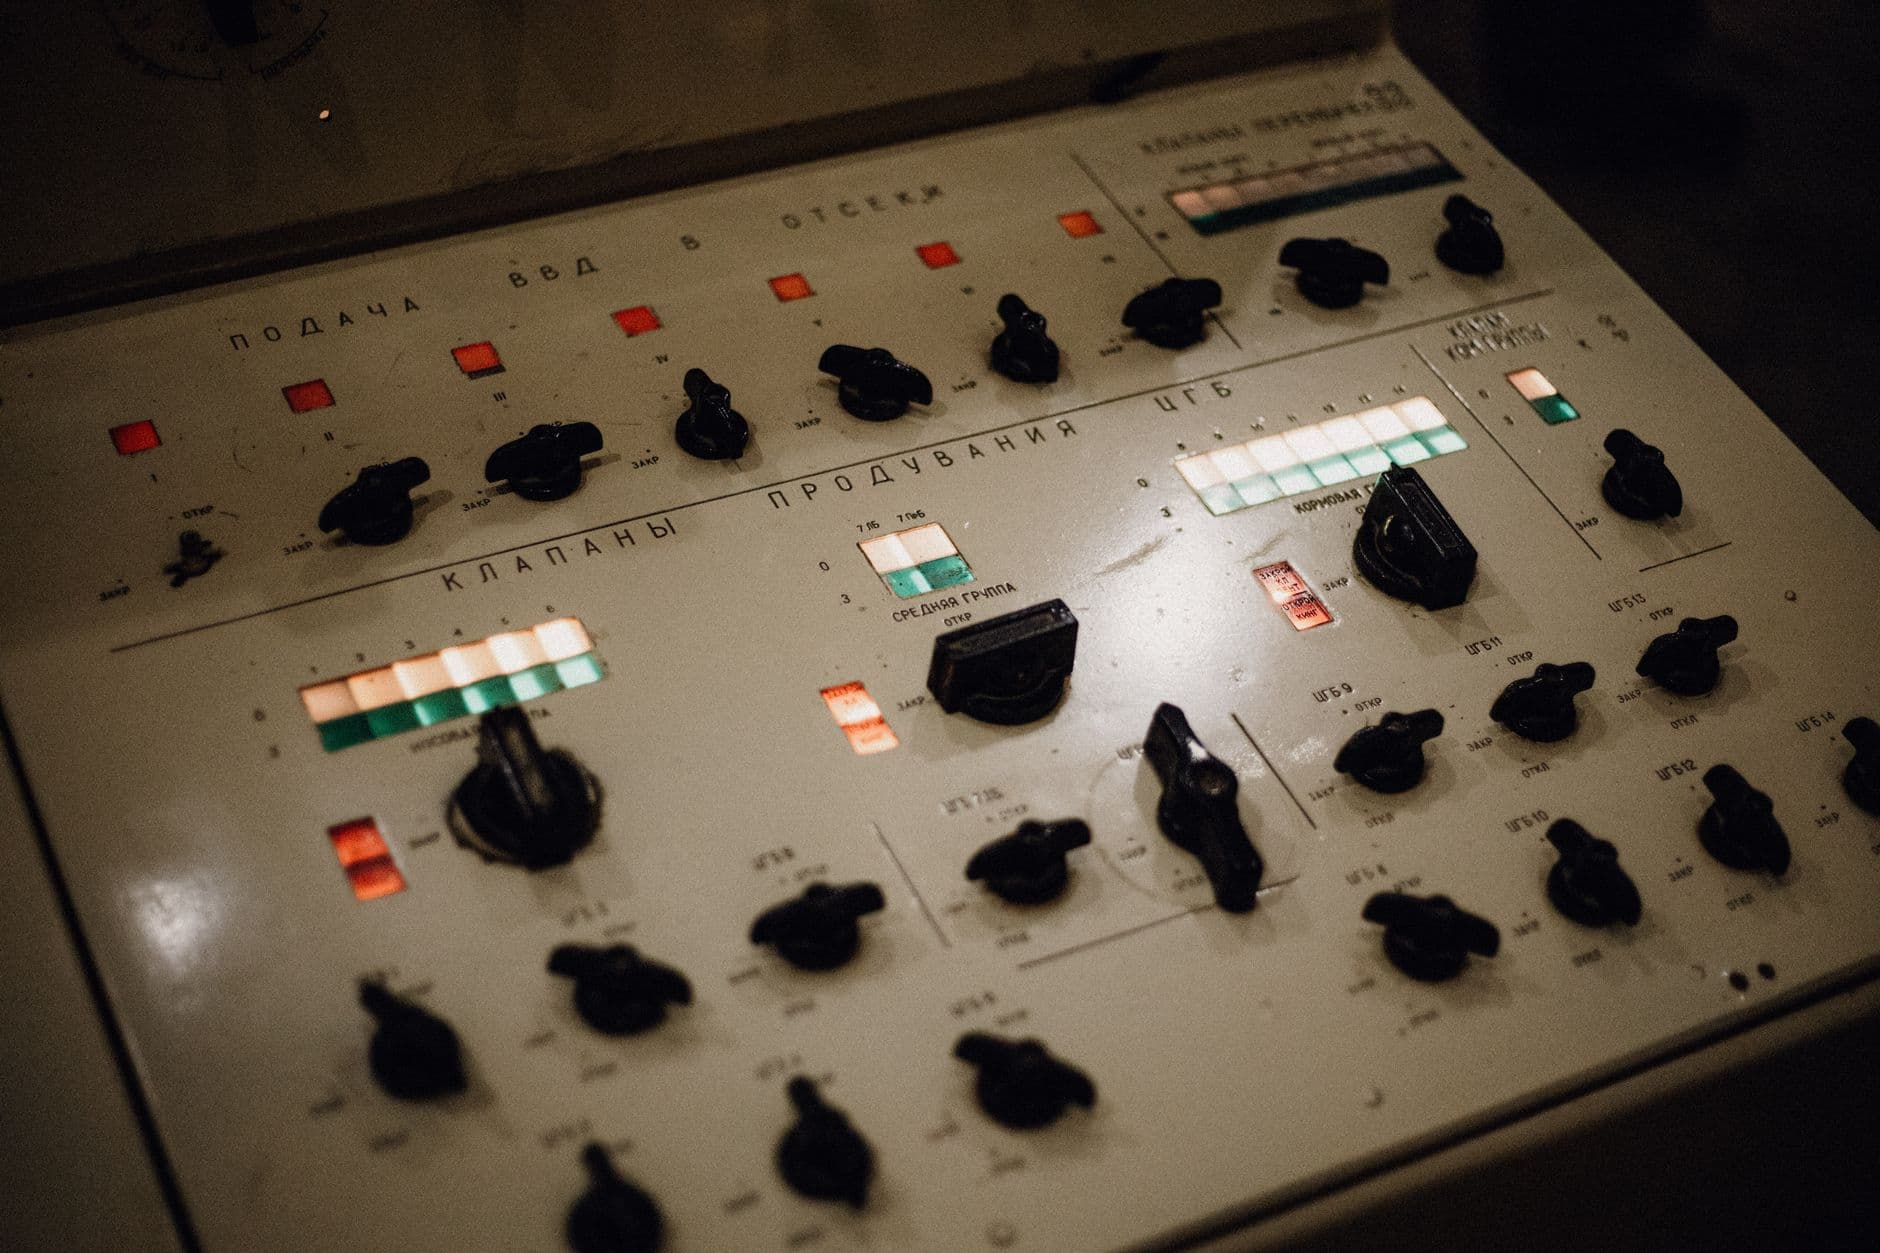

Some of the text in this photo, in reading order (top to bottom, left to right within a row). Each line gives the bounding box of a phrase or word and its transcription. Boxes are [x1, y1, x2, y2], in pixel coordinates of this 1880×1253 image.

[229, 185, 943, 350] ПОДАЧА ВВД В ОТСЕКИ
[493, 390, 507, 403] III
[794, 417, 821, 431] ЗАКР
[631, 455, 660, 470] ЗАКР
[441, 380, 1232, 592] КЛАПАНЫ ПРОДУВАНИЯ ЦГБ
[462, 497, 492, 512] ЗАКР
[1293, 487, 1363, 515] КОРМОВАЯ
[182, 504, 214, 520] ОТКР
[1575, 516, 1600, 532] ЗАКР
[283, 540, 313, 557] ЗАКР
[1322, 576, 1349, 592] ЗАКР
[891, 581, 1018, 624] СРЕДНЯЯ ГРУППА
[1281, 594, 1316, 612] ОТКРОЙ
[943, 611, 973, 628] ОТКР
[1648, 606, 1674, 621] ОТКР
[1506, 650, 1534, 666] ОТКР
[1354, 696, 1383, 713] ОТКР
[1616, 688, 1643, 705] ЗАКР
[1669, 713, 1699, 731] ОТКЛ
[1466, 736, 1494, 753] ЗАКР
[1520, 761, 1550, 780] ОТКЛ
